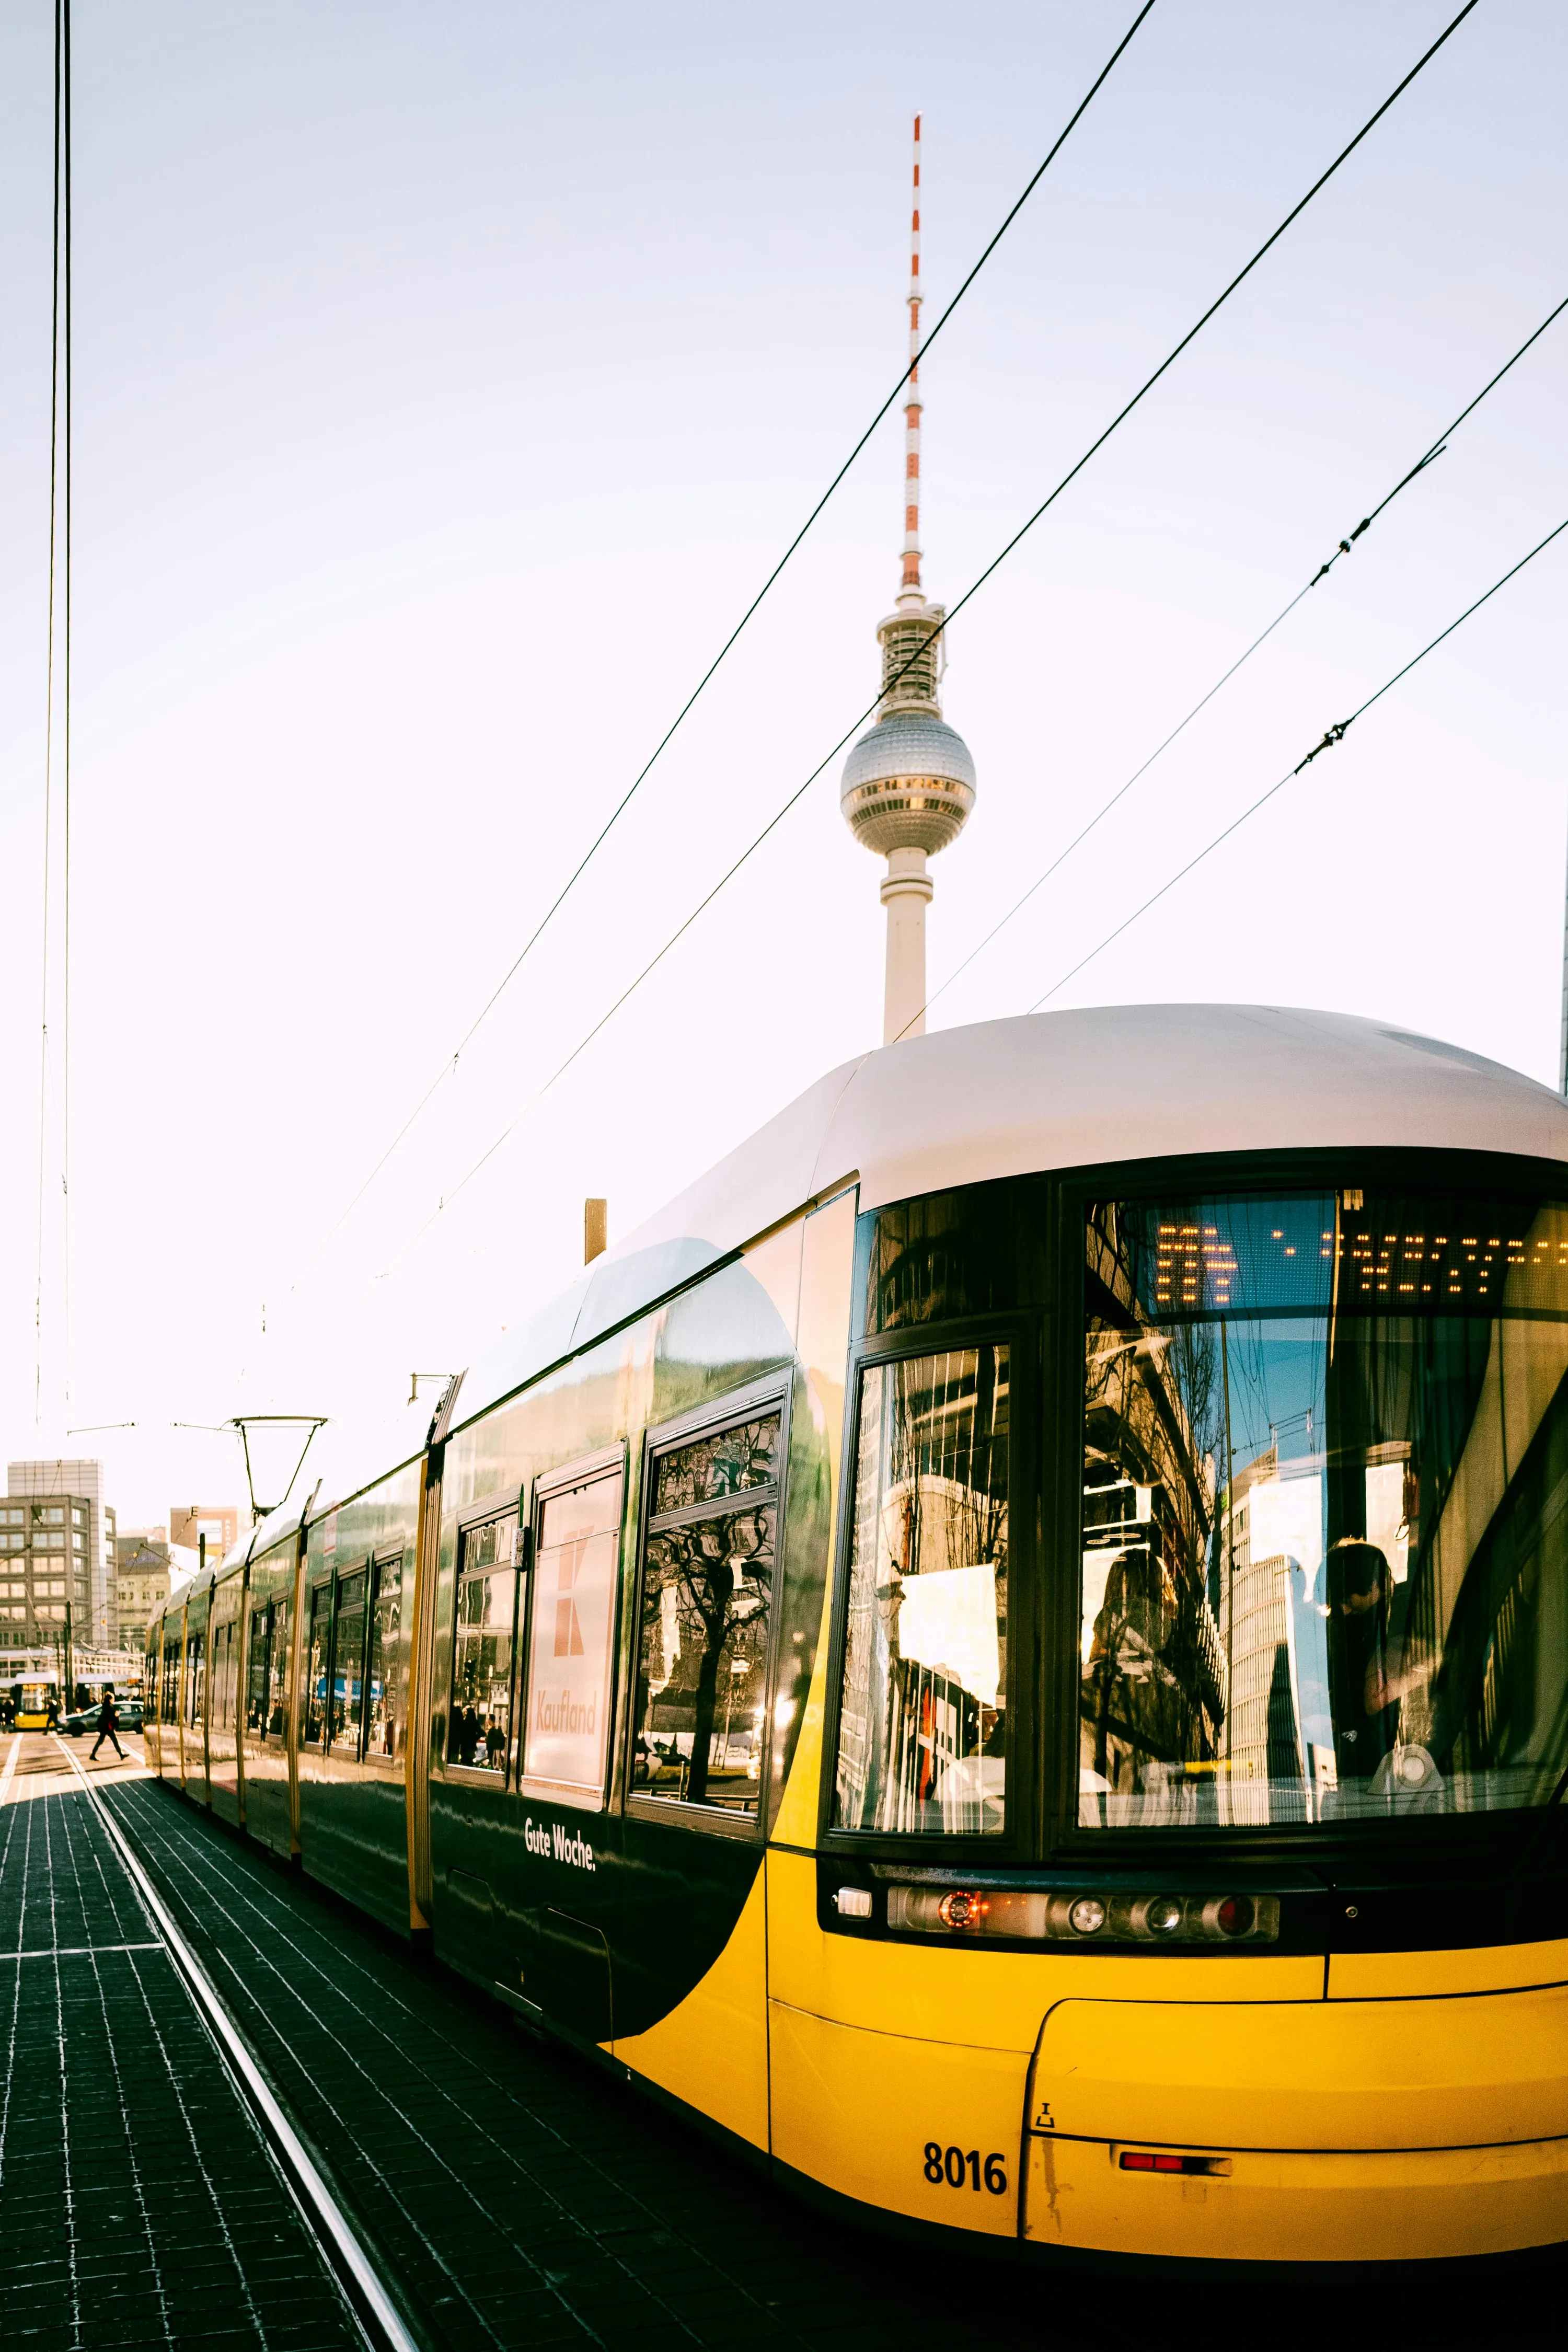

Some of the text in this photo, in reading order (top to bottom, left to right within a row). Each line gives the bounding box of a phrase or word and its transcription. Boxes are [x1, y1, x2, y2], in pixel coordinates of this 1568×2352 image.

[536, 1689, 596, 1736] Kaufland
[525, 1817, 596, 1872] Gute Woche.
[924, 2141, 1007, 2195] 8016
